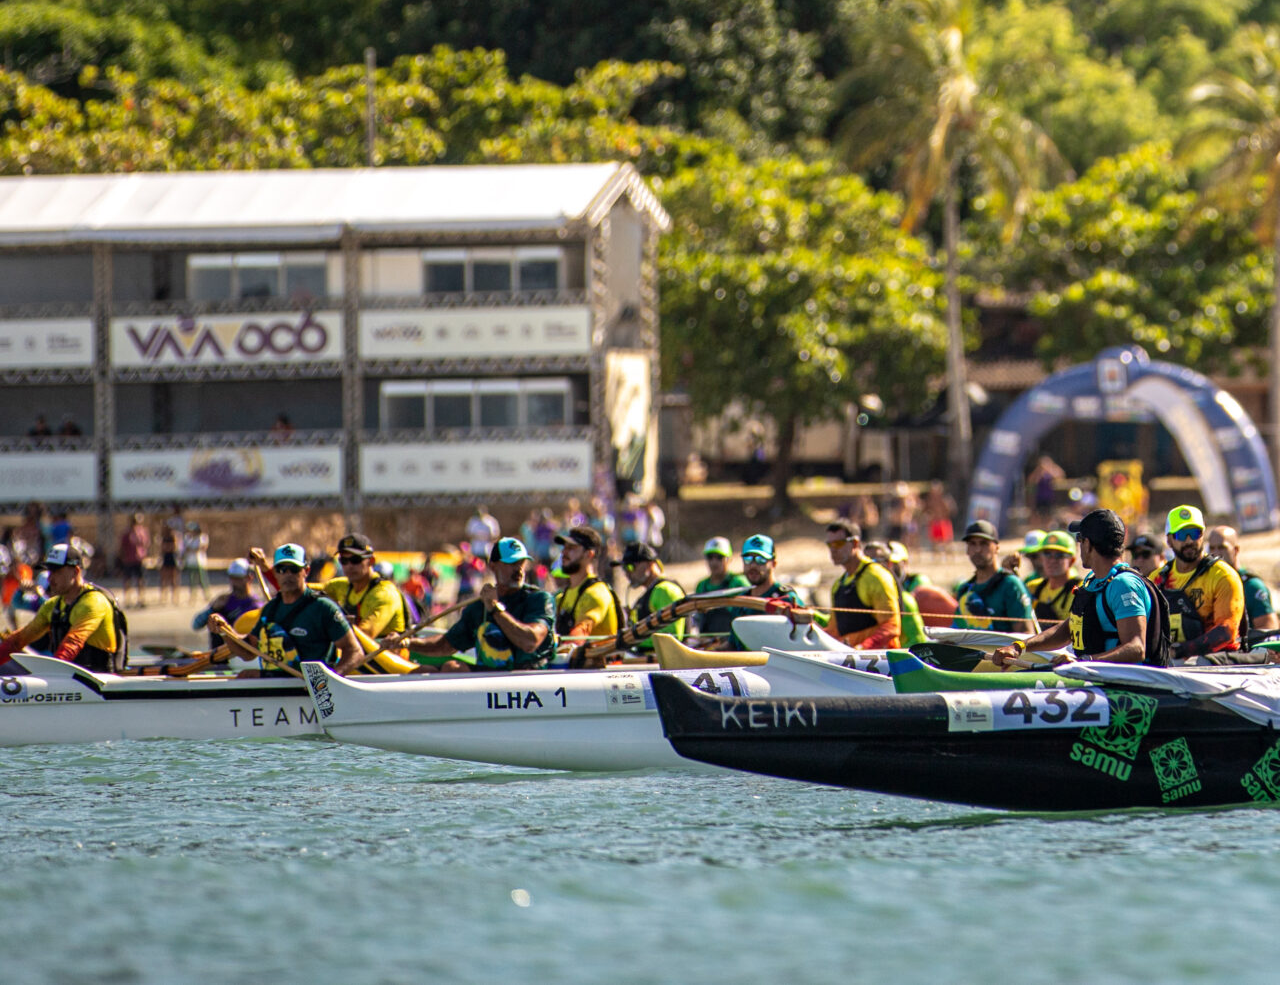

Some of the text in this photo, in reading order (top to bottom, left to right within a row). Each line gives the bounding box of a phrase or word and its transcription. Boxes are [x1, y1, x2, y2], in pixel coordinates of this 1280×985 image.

[487, 686, 567, 709] ILHA 1
[1002, 688, 1101, 725] 432
[229, 708, 318, 727] TEAM
[720, 701, 818, 730] KEIKI
[1069, 741, 1133, 782] samu
[1161, 777, 1202, 804] samu
